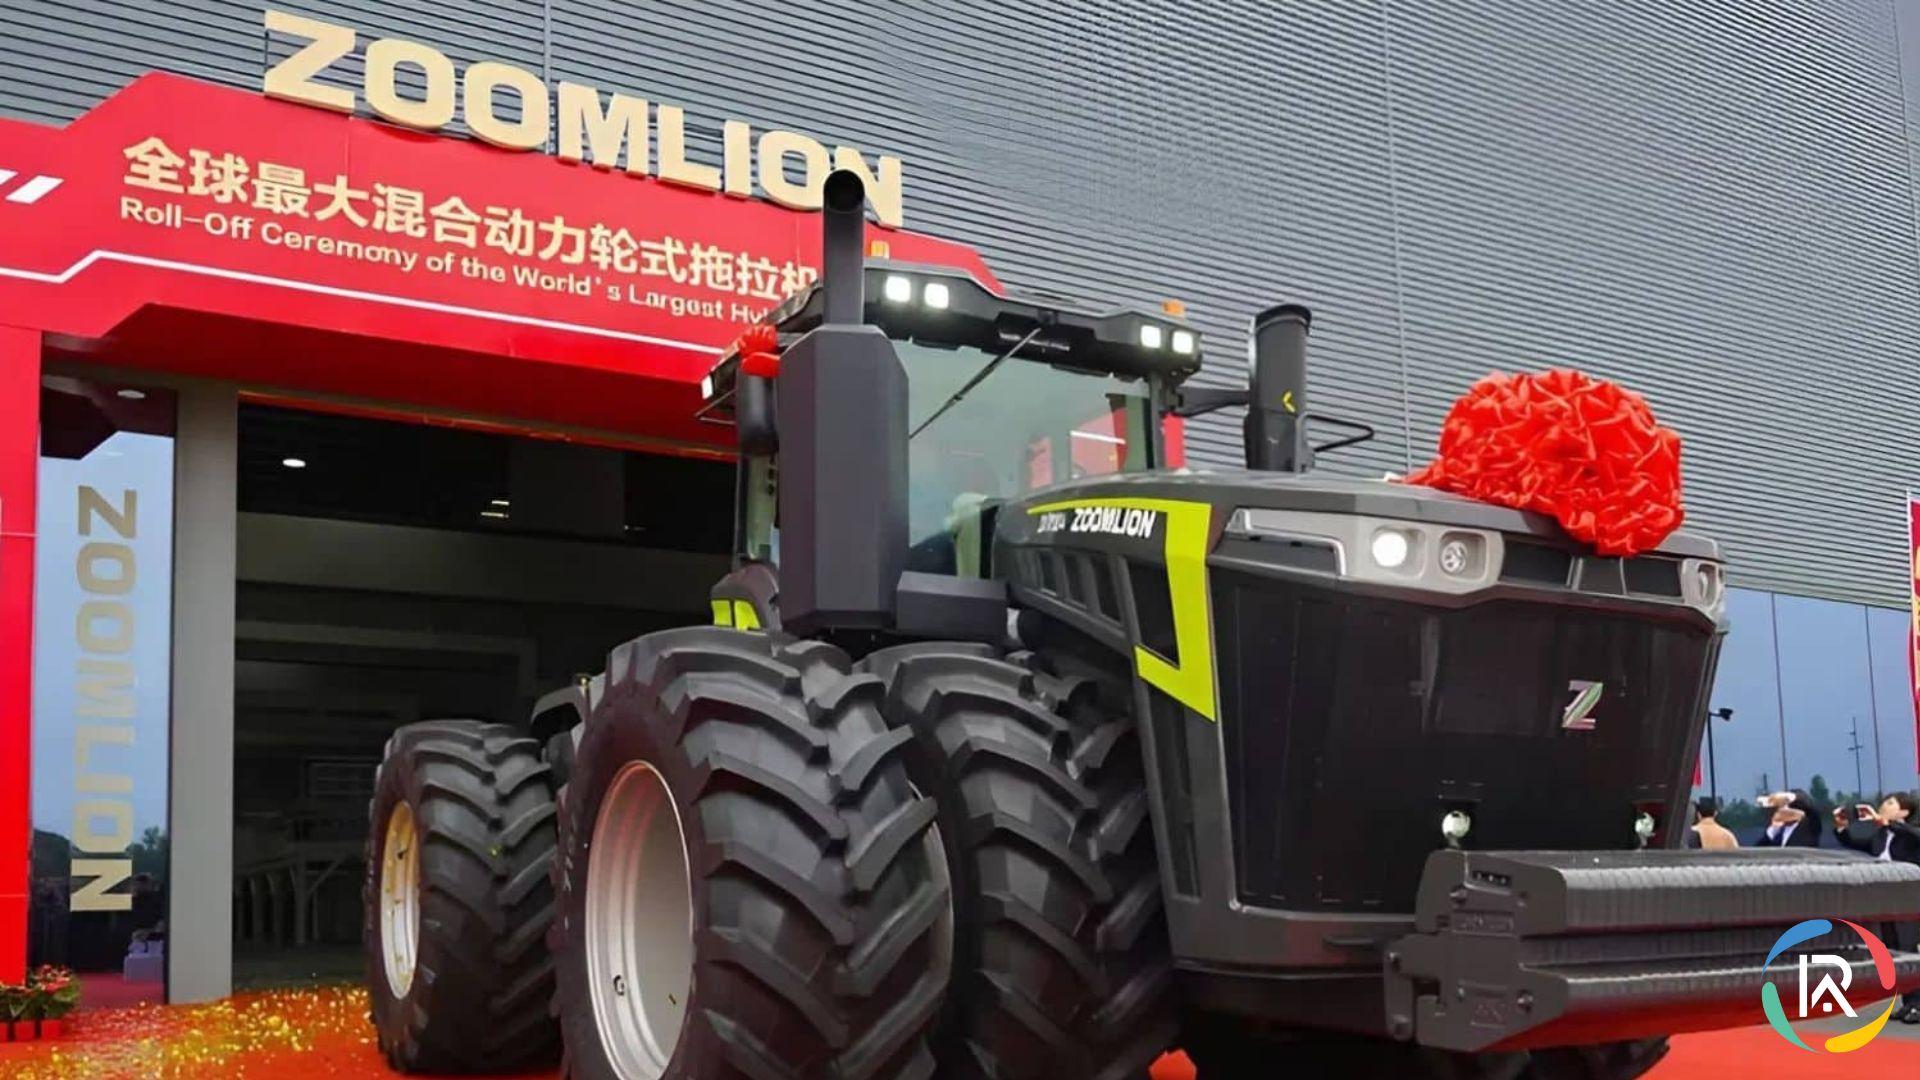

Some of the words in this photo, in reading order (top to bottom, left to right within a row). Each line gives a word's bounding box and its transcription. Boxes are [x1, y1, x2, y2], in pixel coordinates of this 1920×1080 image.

[264, 10, 903, 228] ZOOMLION
[261, 221, 418, 272] Ceremony
[426, 251, 455, 274] of
[461, 256, 506, 283] the
[629, 284, 724, 321] Largest
[1070, 506, 1157, 539] ZOOMLION
[69, 485, 138, 912] ZOOMLION
